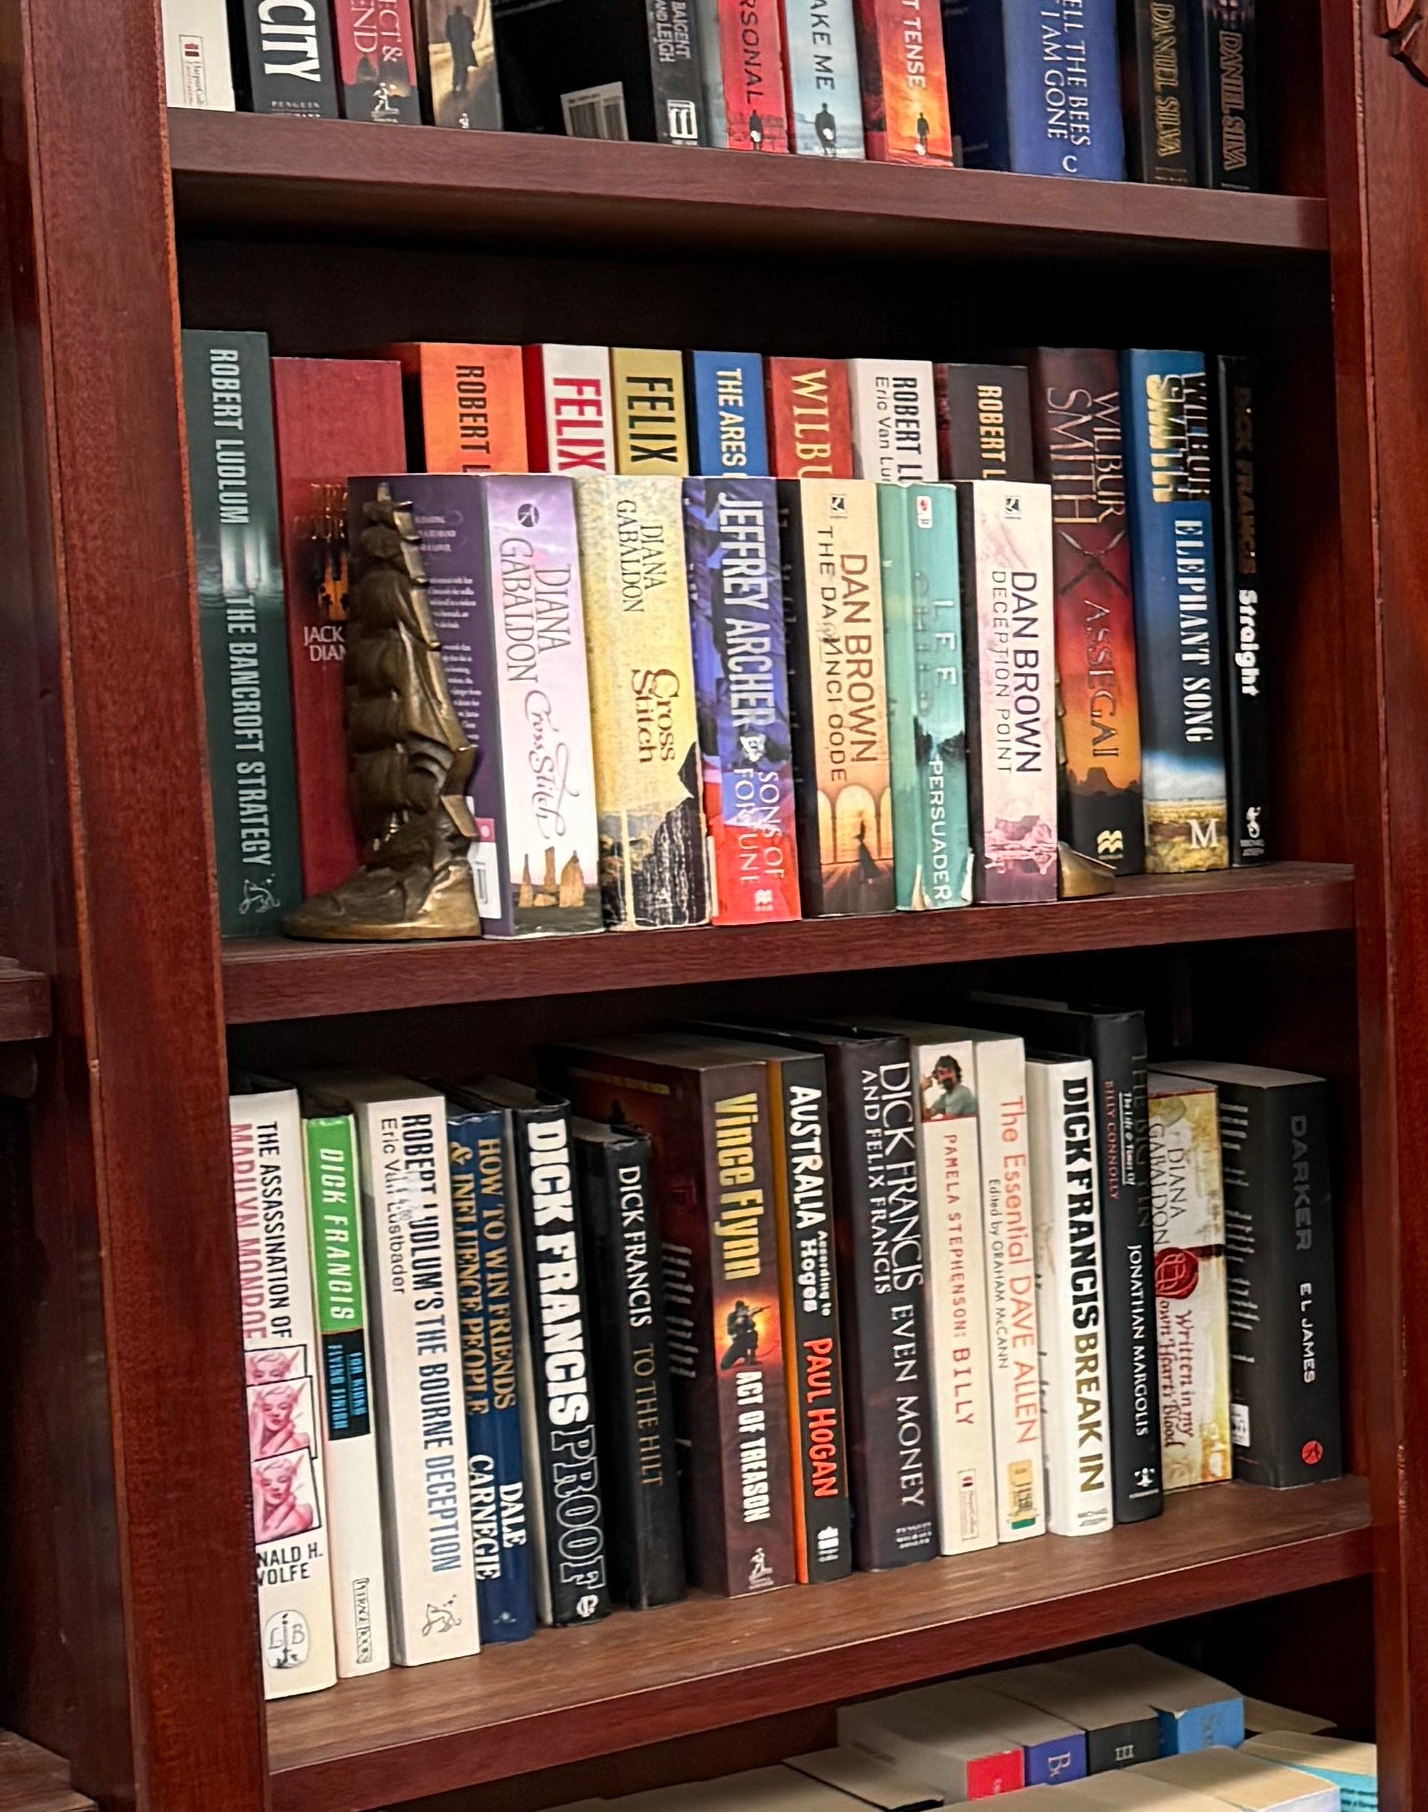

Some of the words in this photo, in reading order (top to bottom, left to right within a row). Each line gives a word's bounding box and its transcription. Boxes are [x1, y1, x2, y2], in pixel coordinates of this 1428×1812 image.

[813, 54, 836, 90] ME
[903, 17, 926, 89] TENSE
[1065, 40, 1087, 88] THE
[1068, 96, 1091, 146] BEES
[210, 348, 243, 430] ROBERT
[455, 364, 491, 454] ROBERT
[553, 377, 607, 472] FELIX
[626, 376, 678, 463] FELIX
[716, 367, 744, 408] THE
[215, 438, 249, 524] LUDLUM
[719, 411, 747, 467] ARES
[1048, 387, 1098, 524] SMITH
[1093, 391, 1126, 522] WILBUR
[616, 499, 645, 613] GABALDON
[640, 524, 668, 591] DIANA
[717, 491, 770, 610] JEFFREY
[840, 553, 871, 624] DAN
[1175, 520, 1211, 666] ELEPHANT
[225, 594, 256, 634] THE
[501, 537, 538, 683] GABALDON
[535, 563, 572, 654] DIANA
[992, 570, 1011, 697] DECEPTION
[1011, 570, 1040, 640] DAN
[228, 642, 264, 753] BANCROFT
[724, 617, 776, 728] ARCHER
[845, 635, 878, 763] BROWN
[1014, 649, 1042, 773] BROWN
[1183, 677, 1214, 742] SONG
[996, 708, 1013, 774] POINT
[236, 761, 272, 866] STRATEGY
[929, 758, 953, 901] PERSUADER
[861, 1069, 881, 1121] AND
[879, 1061, 916, 1157] DICK
[1000, 1095, 1026, 1143] The
[1062, 1077, 1092, 1166] DICK
[256, 1121, 279, 1157] THE
[320, 1148, 347, 1205] DICK
[478, 1138, 504, 1197] HOW
[527, 1118, 574, 1226] DICK
[714, 1092, 759, 1187] Vince
[788, 1085, 827, 1230] AUSTRALIA
[865, 1128, 886, 1188] FELIX
[943, 1133, 960, 1204] PAMELA
[481, 1204, 506, 1240] TO
[618, 1165, 645, 1226] DICK
[886, 1160, 924, 1292] FRANCIS
[1003, 1152, 1031, 1265] Essential
[1149, 1123, 1171, 1245] GABALDON
[1167, 1147, 1187, 1219] DIANA
[1291, 1115, 1312, 1251] DARKER
[259, 1164, 290, 1308] ASSASSINATION
[324, 1215, 355, 1321] FRANCIS
[484, 1246, 509, 1301] WIN
[713, 1189, 764, 1281] Flynn
[870, 1197, 892, 1294] FRANCIS
[948, 1212, 967, 1338] STEPHENSON:
[1066, 1168, 1099, 1330] FRANCIS
[623, 1232, 653, 1328] FRANCIS
[1009, 1276, 1035, 1350] DAVE
[271, 1314, 292, 1339] OF
[488, 1302, 516, 1410] FRIENDS
[536, 1230, 590, 1426] FRANCIS
[632, 1342, 656, 1377] TO
[890, 1304, 918, 1382] EVEN
[635, 1381, 658, 1429] THE
[735, 1371, 763, 1405] ACT
[803, 1338, 834, 1404] PAUL
[953, 1347, 974, 1426] BILLY
[1013, 1360, 1038, 1445] ALLEN
[1074, 1333, 1103, 1448] BREAK
[638, 1435, 663, 1487] HILT
[737, 1411, 765, 1434] OF
[807, 1407, 839, 1498] HOGAN
[896, 1395, 925, 1507] MONEY
[499, 1481, 527, 1549] DALE
[551, 1424, 606, 1590] PROOF
[739, 1436, 771, 1523] TREASON
[1078, 1453, 1105, 1493] IN
[468, 1454, 501, 1581] CARNEGIE
